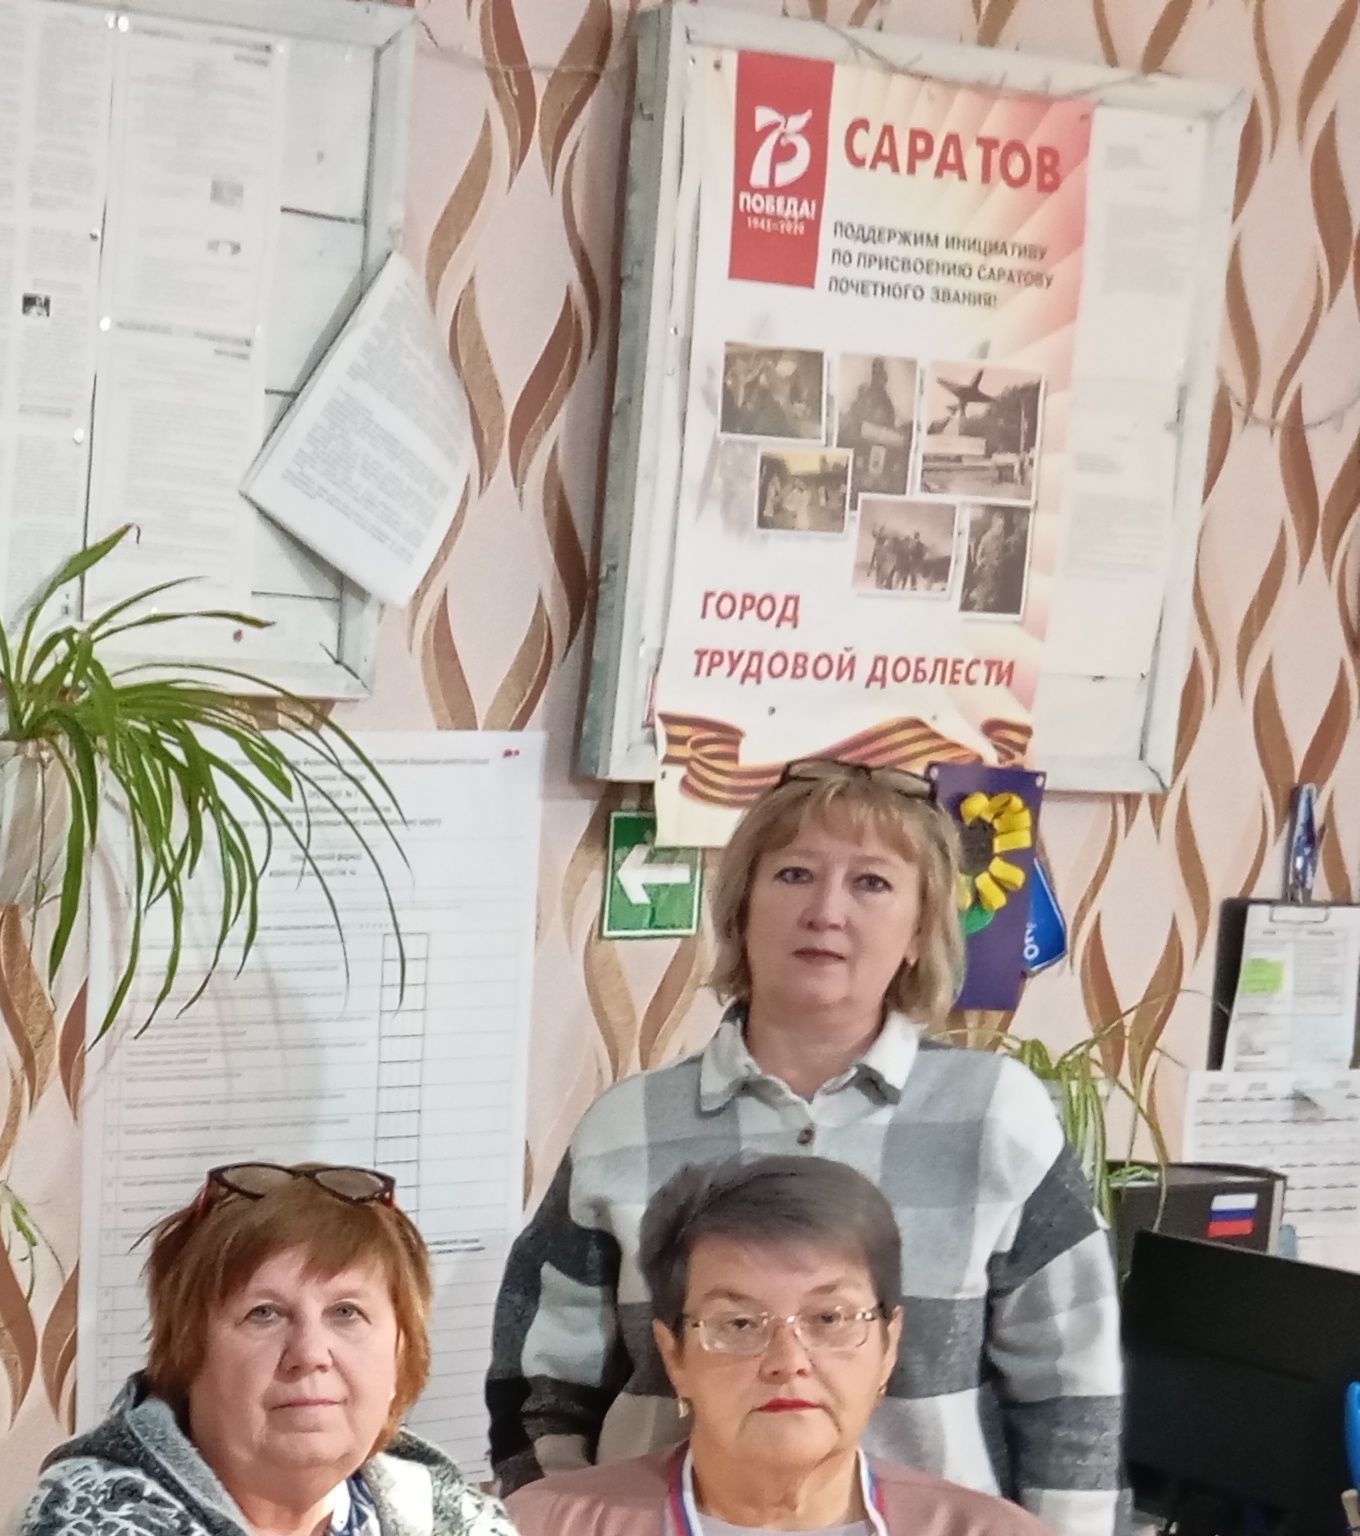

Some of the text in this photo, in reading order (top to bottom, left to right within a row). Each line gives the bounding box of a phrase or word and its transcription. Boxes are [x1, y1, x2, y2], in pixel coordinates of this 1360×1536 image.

[844, 117, 1063, 193] САРАТОВ
[739, 190, 817, 221] ПОБЕДА!
[833, 220, 1048, 262] ПОДДЕРЖИМ ИНИЦИАТИВУ
[831, 248, 1054, 290] ПО ПРИСВОЕНИЮ САРАТОВУ
[828, 275, 998, 309] ПОЧЕТНОГО ЗВАНИЯ!
[700, 590, 801, 629] ГОРОД
[693, 646, 1016, 690] ТРУДОВОЙ ДОБЛЕСТИ
